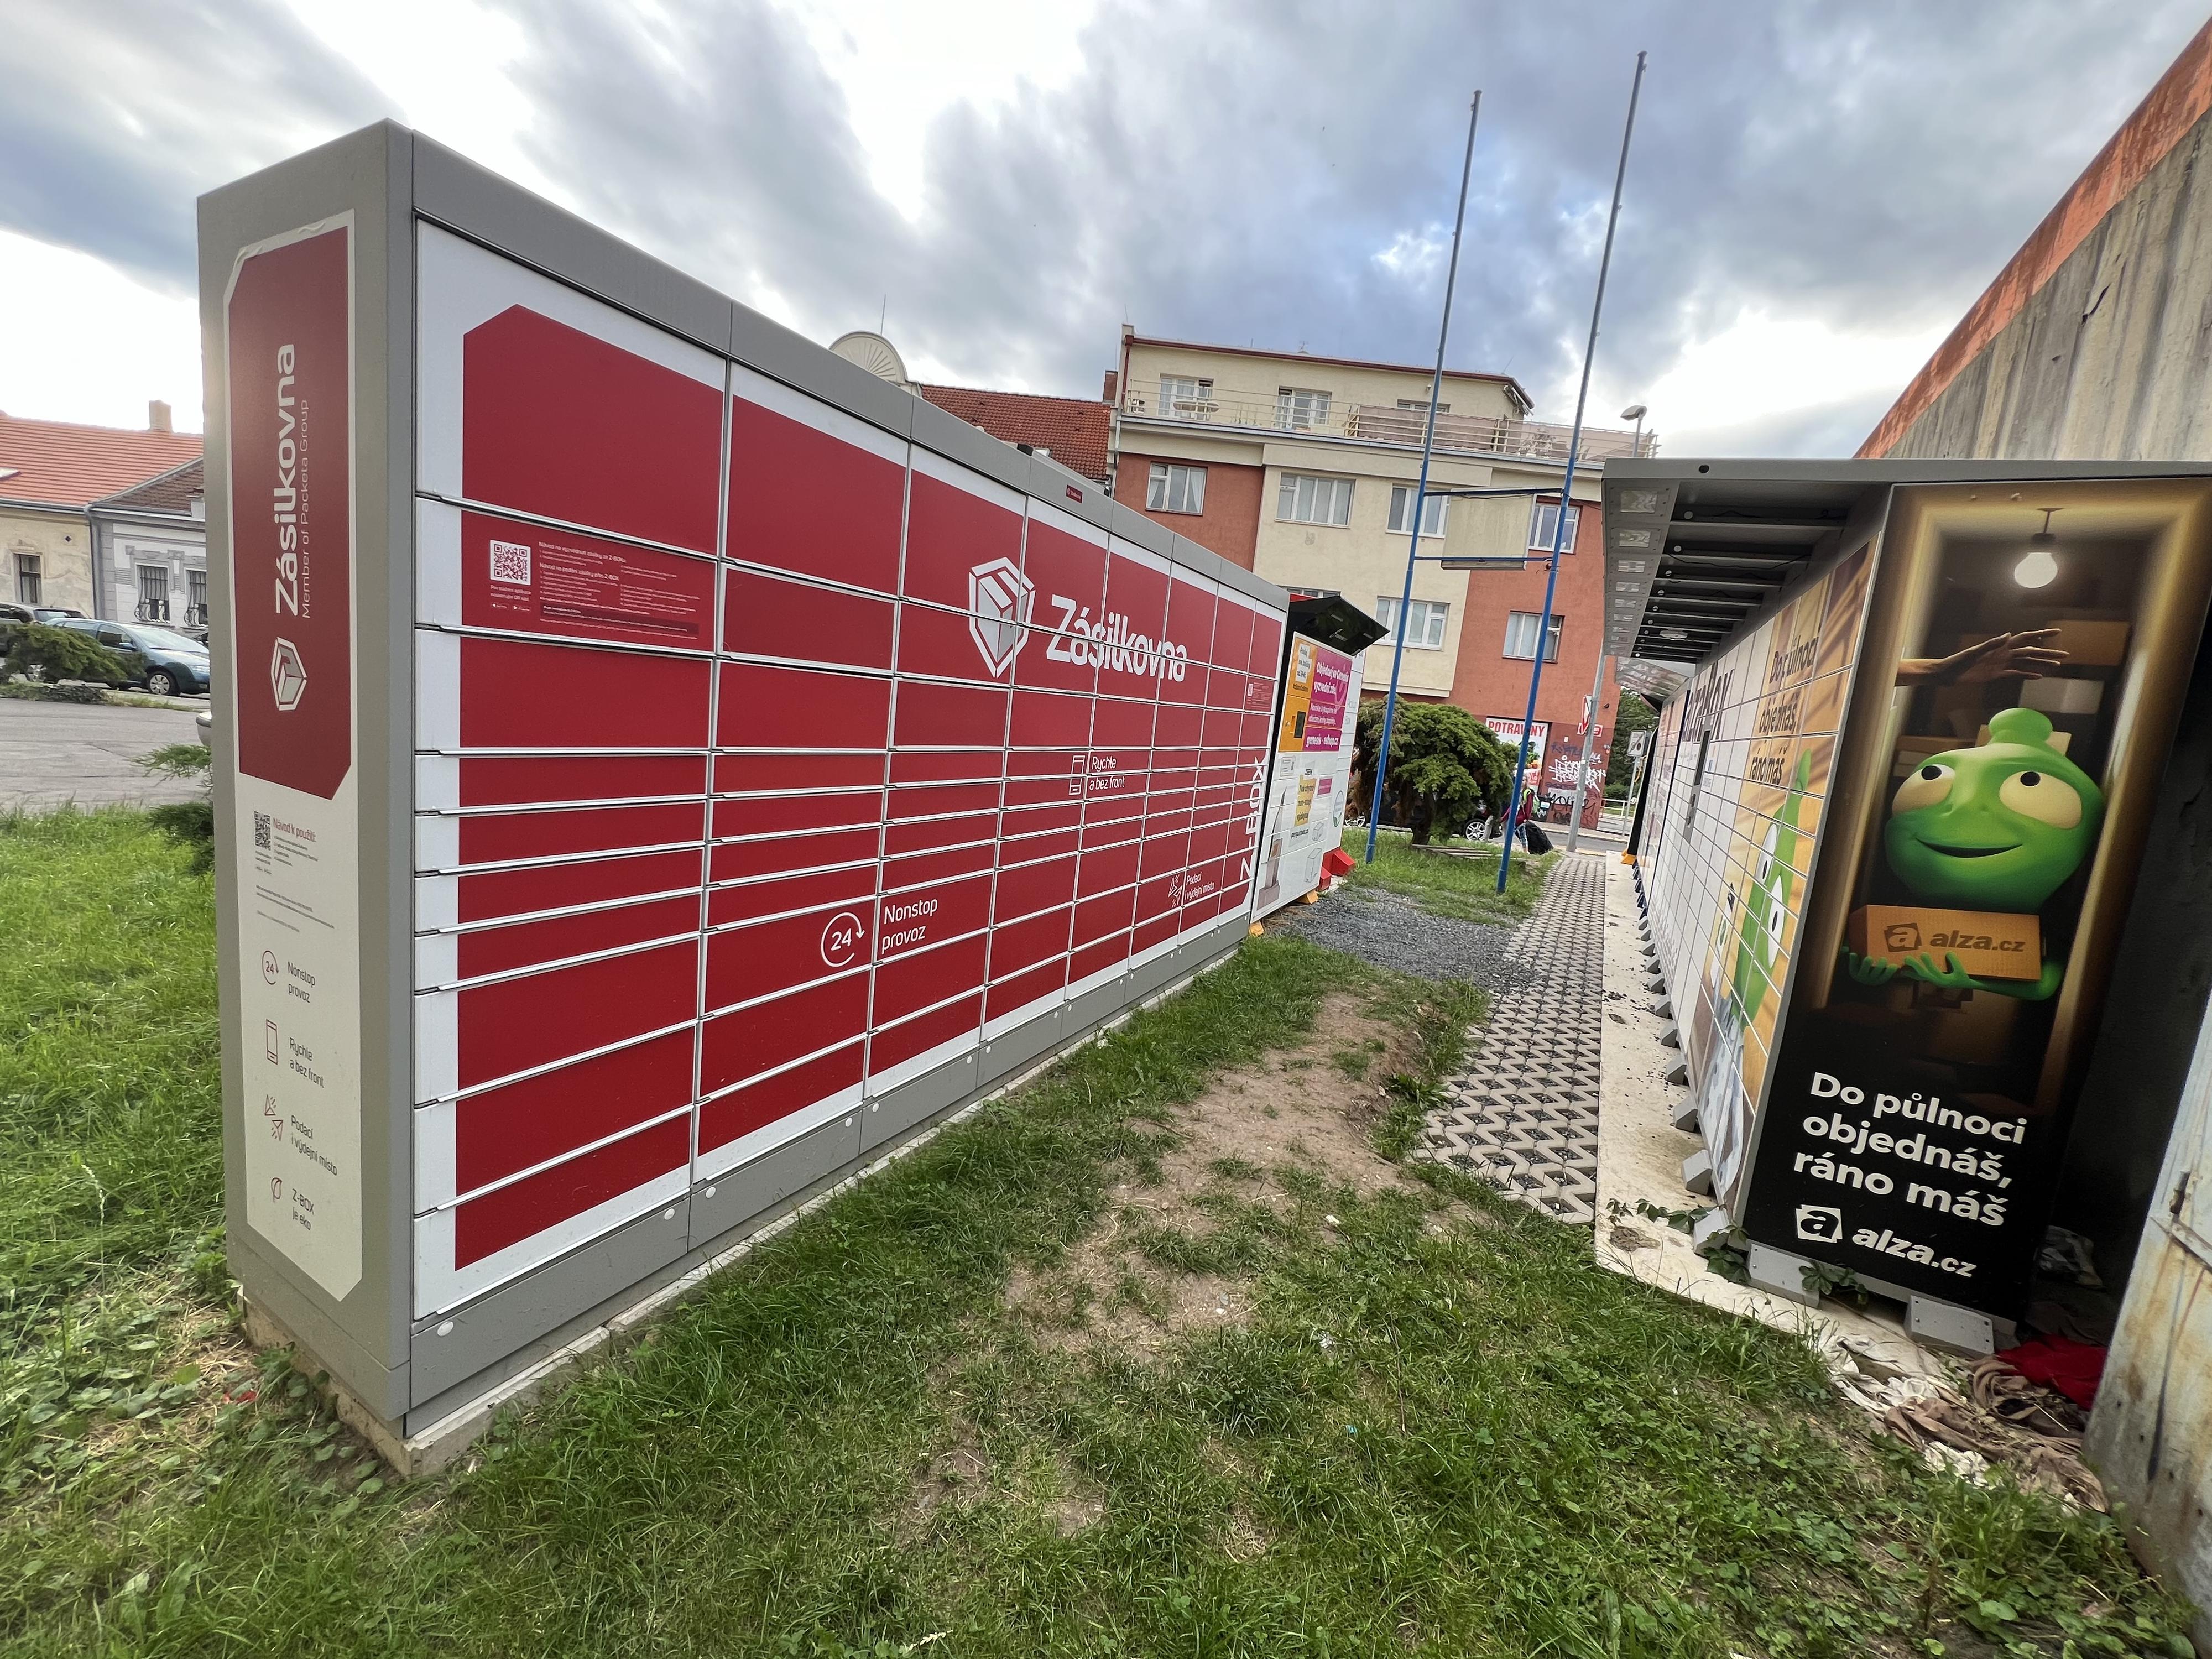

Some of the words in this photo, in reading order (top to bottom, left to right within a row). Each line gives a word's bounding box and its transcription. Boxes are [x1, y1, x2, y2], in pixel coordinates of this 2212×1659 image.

[300, 400, 309, 451] Group
[274, 344, 298, 617] Zásilkovna
[300, 458, 310, 524] Packeta
[301, 531, 310, 544] of
[302, 550, 310, 618] Member
[1046, 594, 1187, 682] Zásilkovna
[1488, 720, 1545, 737] POTRANY
[1092, 756, 1117, 772] Rychle
[1089, 780, 1094, 790] a
[1095, 777, 1109, 790] bez
[1109, 775, 1125, 789] front
[831, 928, 852, 951] 24
[884, 899, 938, 925] Nonstop
[881, 925, 926, 955] provoz
[1929, 930, 2026, 952] alza.cz
[265, 961, 274, 975] 24
[288, 961, 316, 988] Nonstop
[288, 983, 310, 1003] provoz
[289, 1037, 312, 1062] Rychle
[290, 1059, 294, 1070] a
[295, 1059, 307, 1078] bez
[308, 1067, 324, 1088] front
[1811, 1072, 1864, 1104] Do
[1872, 1093, 2027, 1144] půlnoci
[291, 1114, 314, 1140] Podací
[1803, 1113, 2012, 1188] objednáš,
[292, 1188, 314, 1215] Z-BOX
[1793, 1152, 1894, 1195] ráno
[1906, 1182, 2008, 1226] máš
[1852, 1229, 1977, 1277] alza.cz
